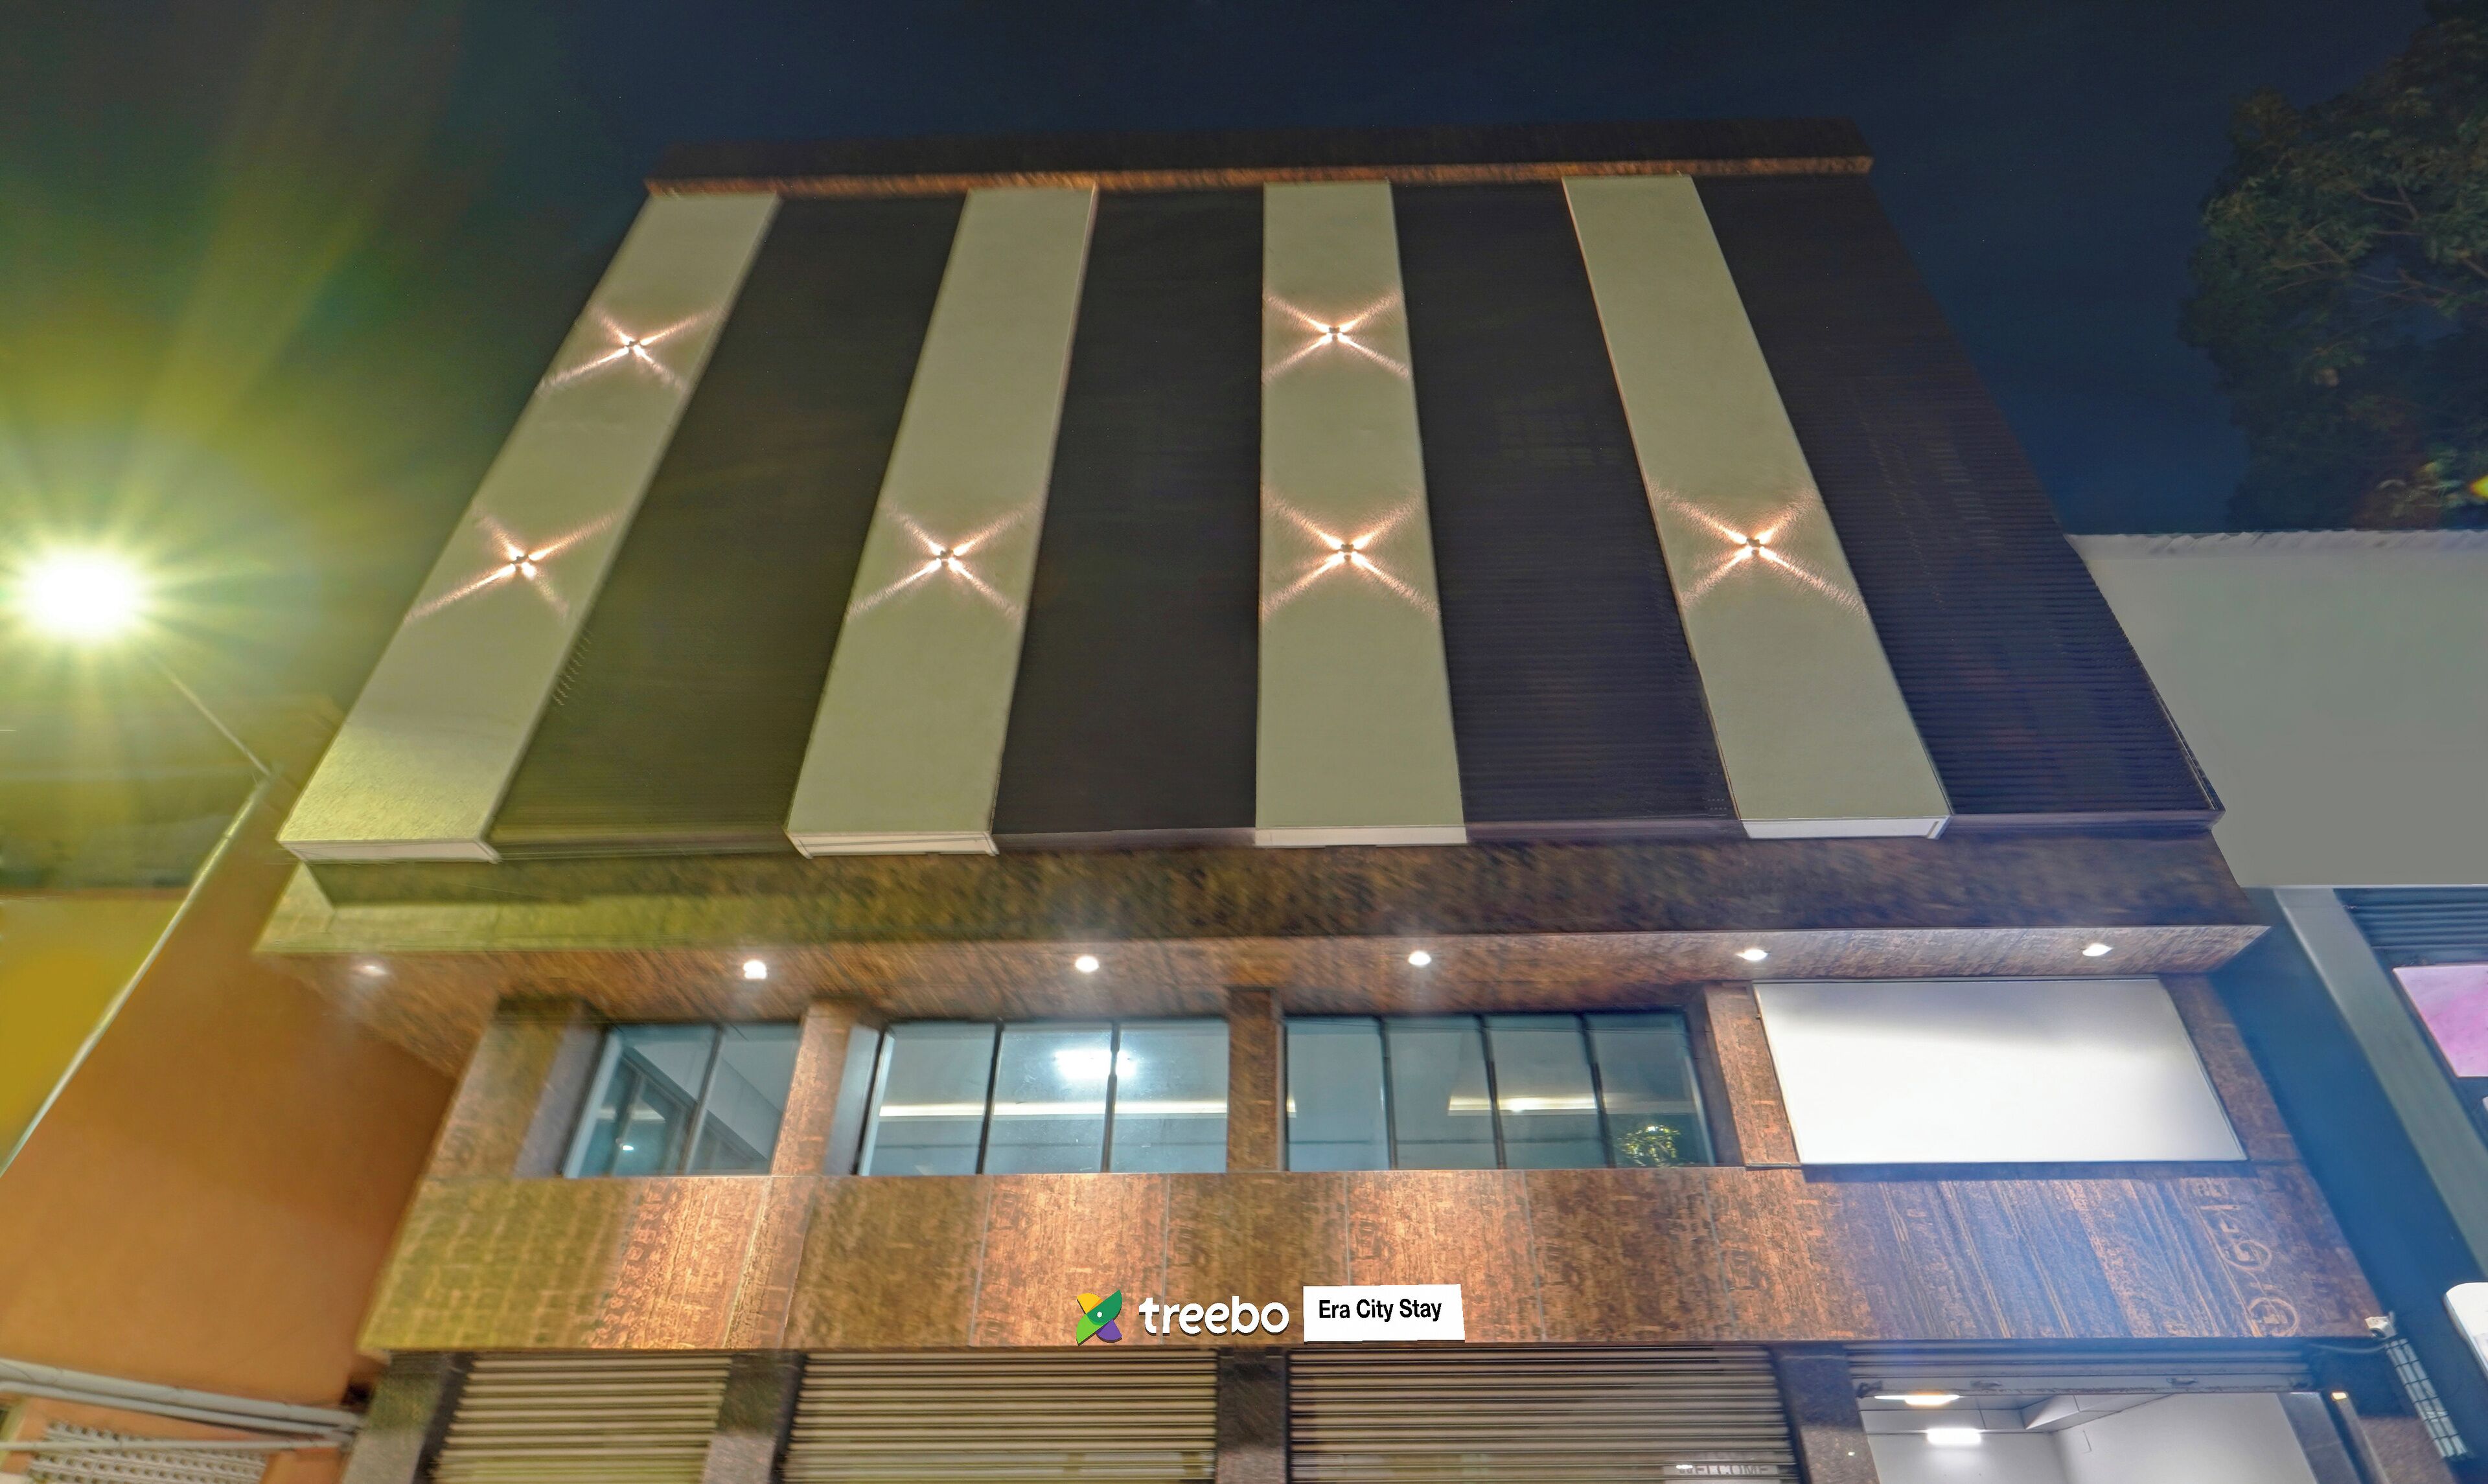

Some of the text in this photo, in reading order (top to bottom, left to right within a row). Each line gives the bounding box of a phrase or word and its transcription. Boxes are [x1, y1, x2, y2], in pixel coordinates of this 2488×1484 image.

[1138, 1296, 1290, 1335] treebo
[1319, 1298, 1442, 1323] Era City Stay
